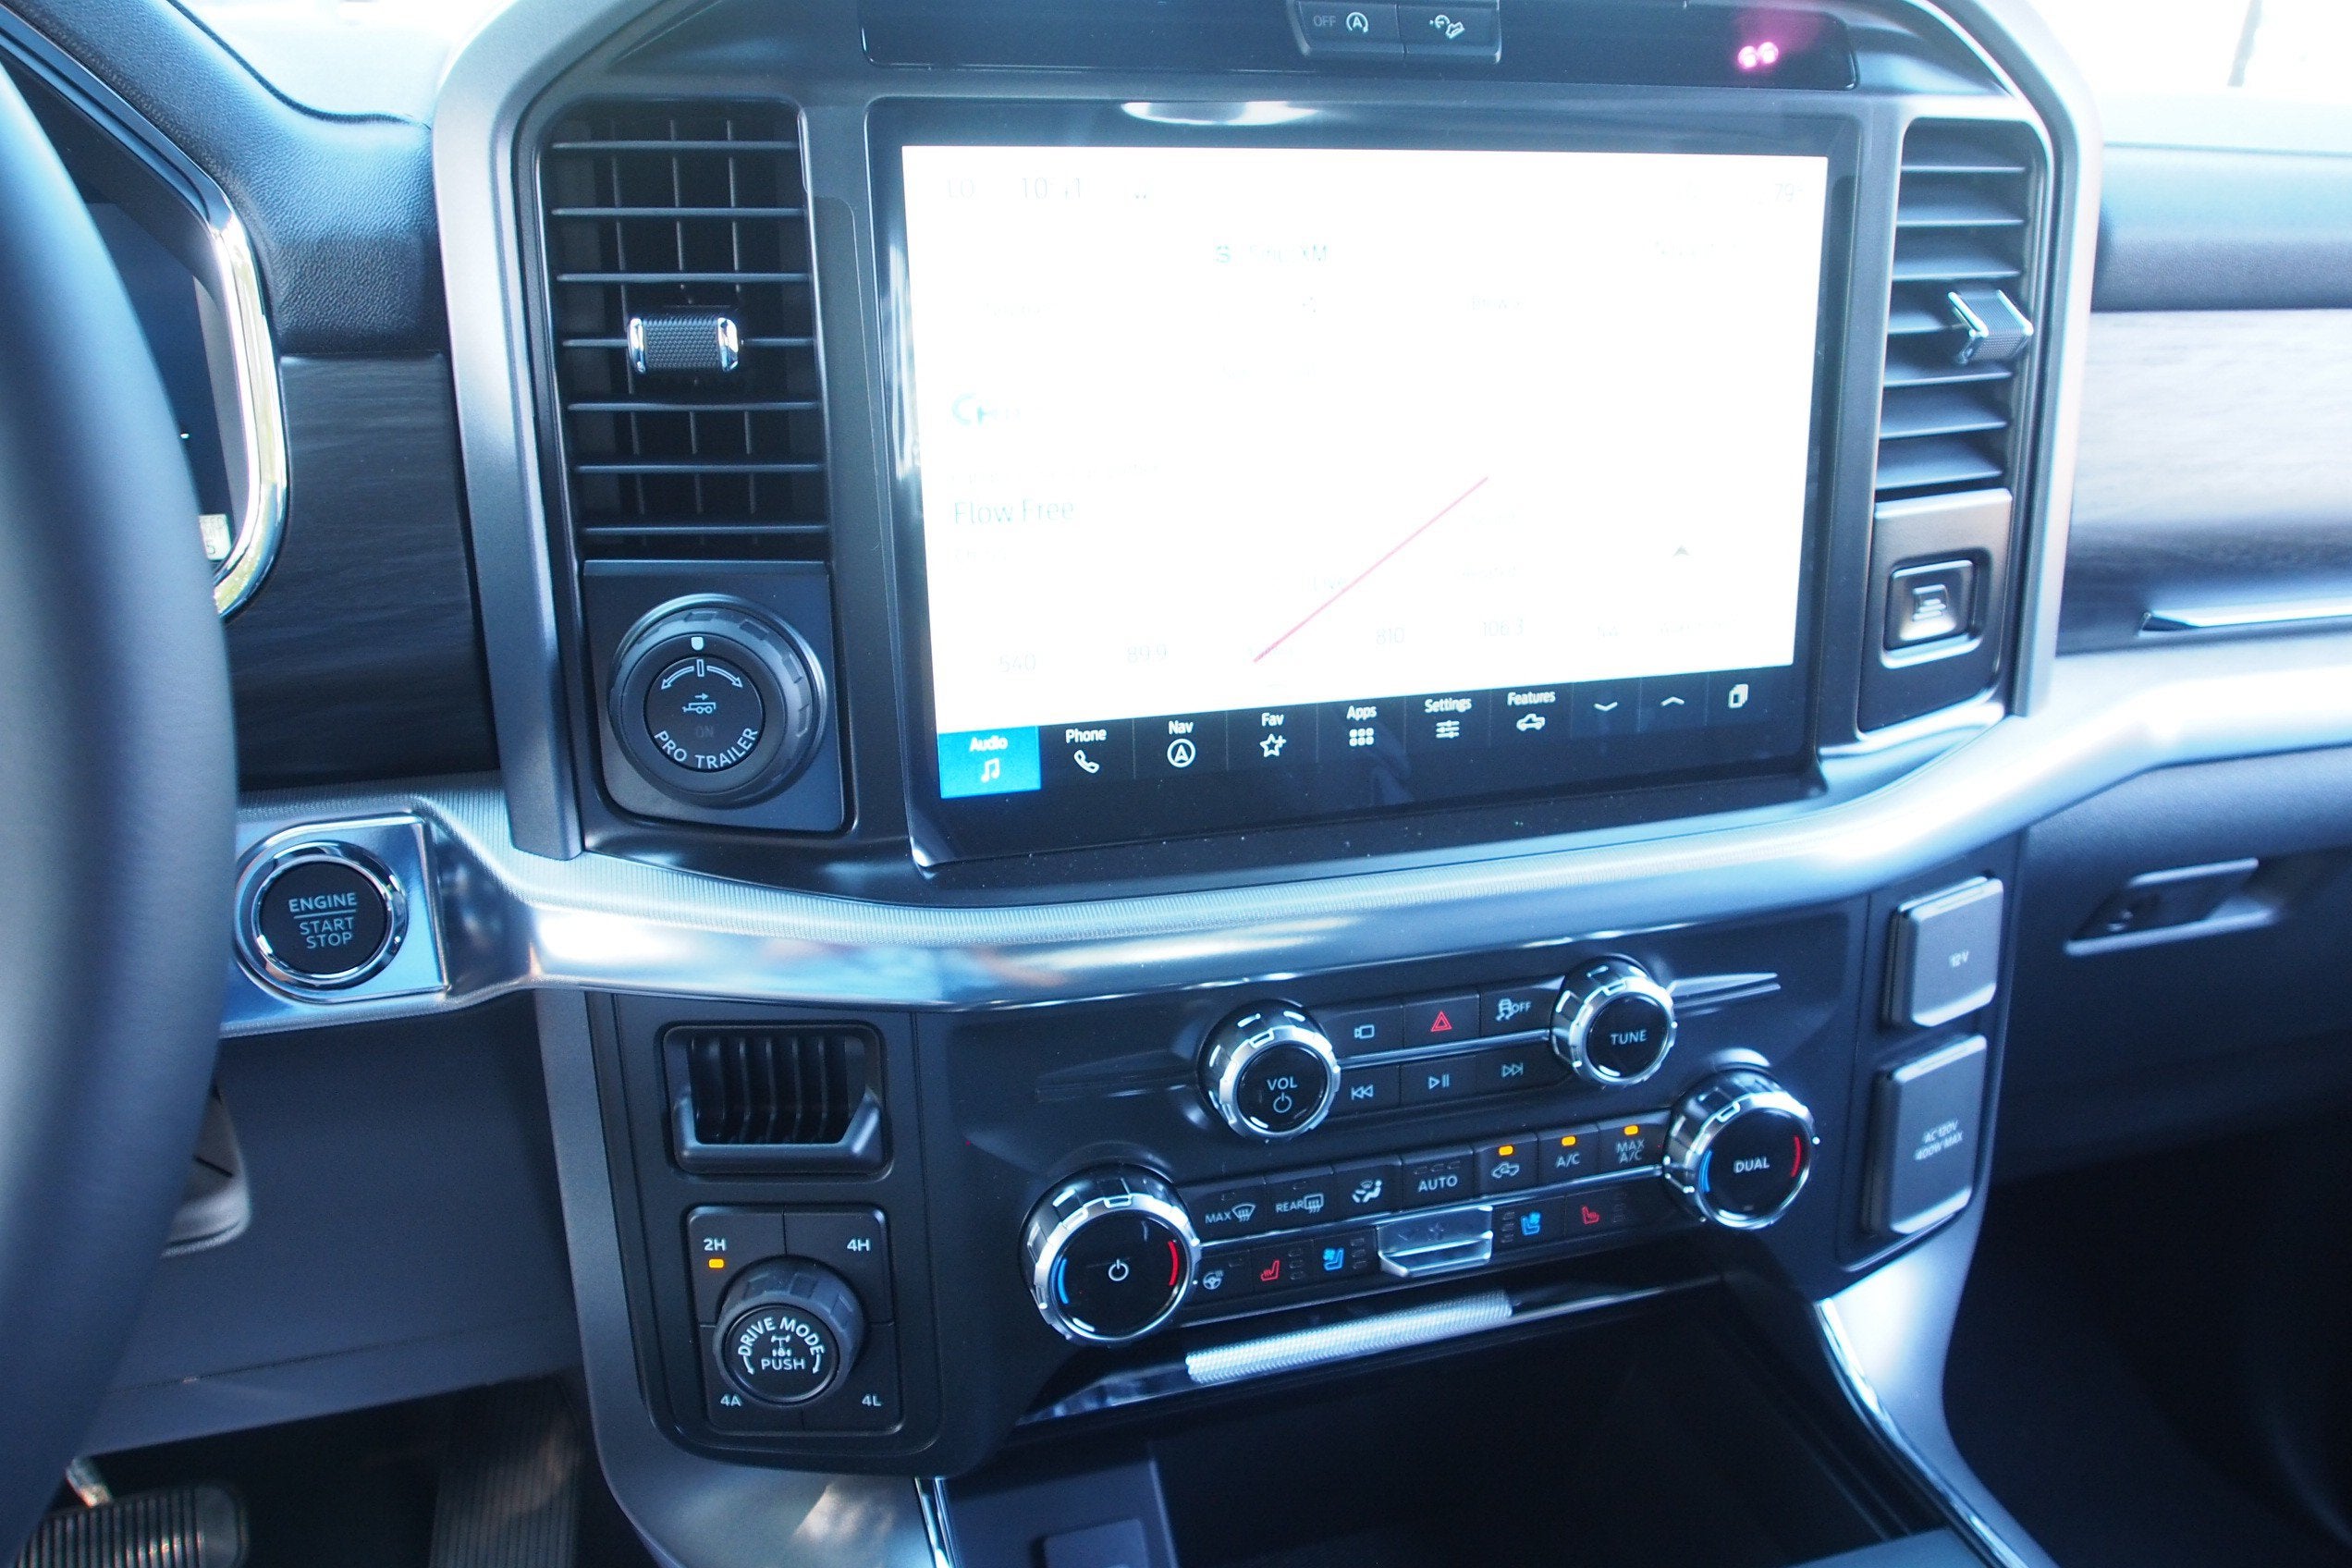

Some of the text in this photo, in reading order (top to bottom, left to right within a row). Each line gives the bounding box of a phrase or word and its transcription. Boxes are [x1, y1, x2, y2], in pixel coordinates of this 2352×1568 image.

[1313, 15, 1337, 27] OFF
[1424, 696, 1473, 715] Settings
[1507, 689, 1556, 707] Features
[1261, 712, 1284, 728] Fav
[1346, 704, 1378, 722] Apps
[1065, 728, 1108, 743] Phone
[1168, 720, 1194, 735] Nav
[654, 727, 759, 769] PRO TRAILER
[969, 735, 1009, 753] Audio
[288, 892, 358, 913] ENGINE
[299, 916, 355, 936] START
[305, 932, 353, 949] STOP
[1510, 999, 1532, 1013] OFF
[1610, 1028, 1648, 1047] TUNE
[1266, 1076, 1299, 1092] VOL
[1615, 1137, 1646, 1155] MAX
[1554, 1151, 1581, 1170] A/C
[1618, 1149, 1643, 1165] A/C
[1733, 1156, 1770, 1174] DUAL
[1417, 1175, 1458, 1194] AUTO
[1275, 1200, 1305, 1214] REAR
[1204, 1210, 1232, 1225] MAX
[703, 1238, 728, 1252] 2H
[846, 1238, 872, 1252] 4H
[737, 1317, 826, 1357] DRIVE MODE
[760, 1357, 806, 1371] PUSH
[720, 1394, 742, 1407] 4A
[861, 1394, 883, 1407] 4L
